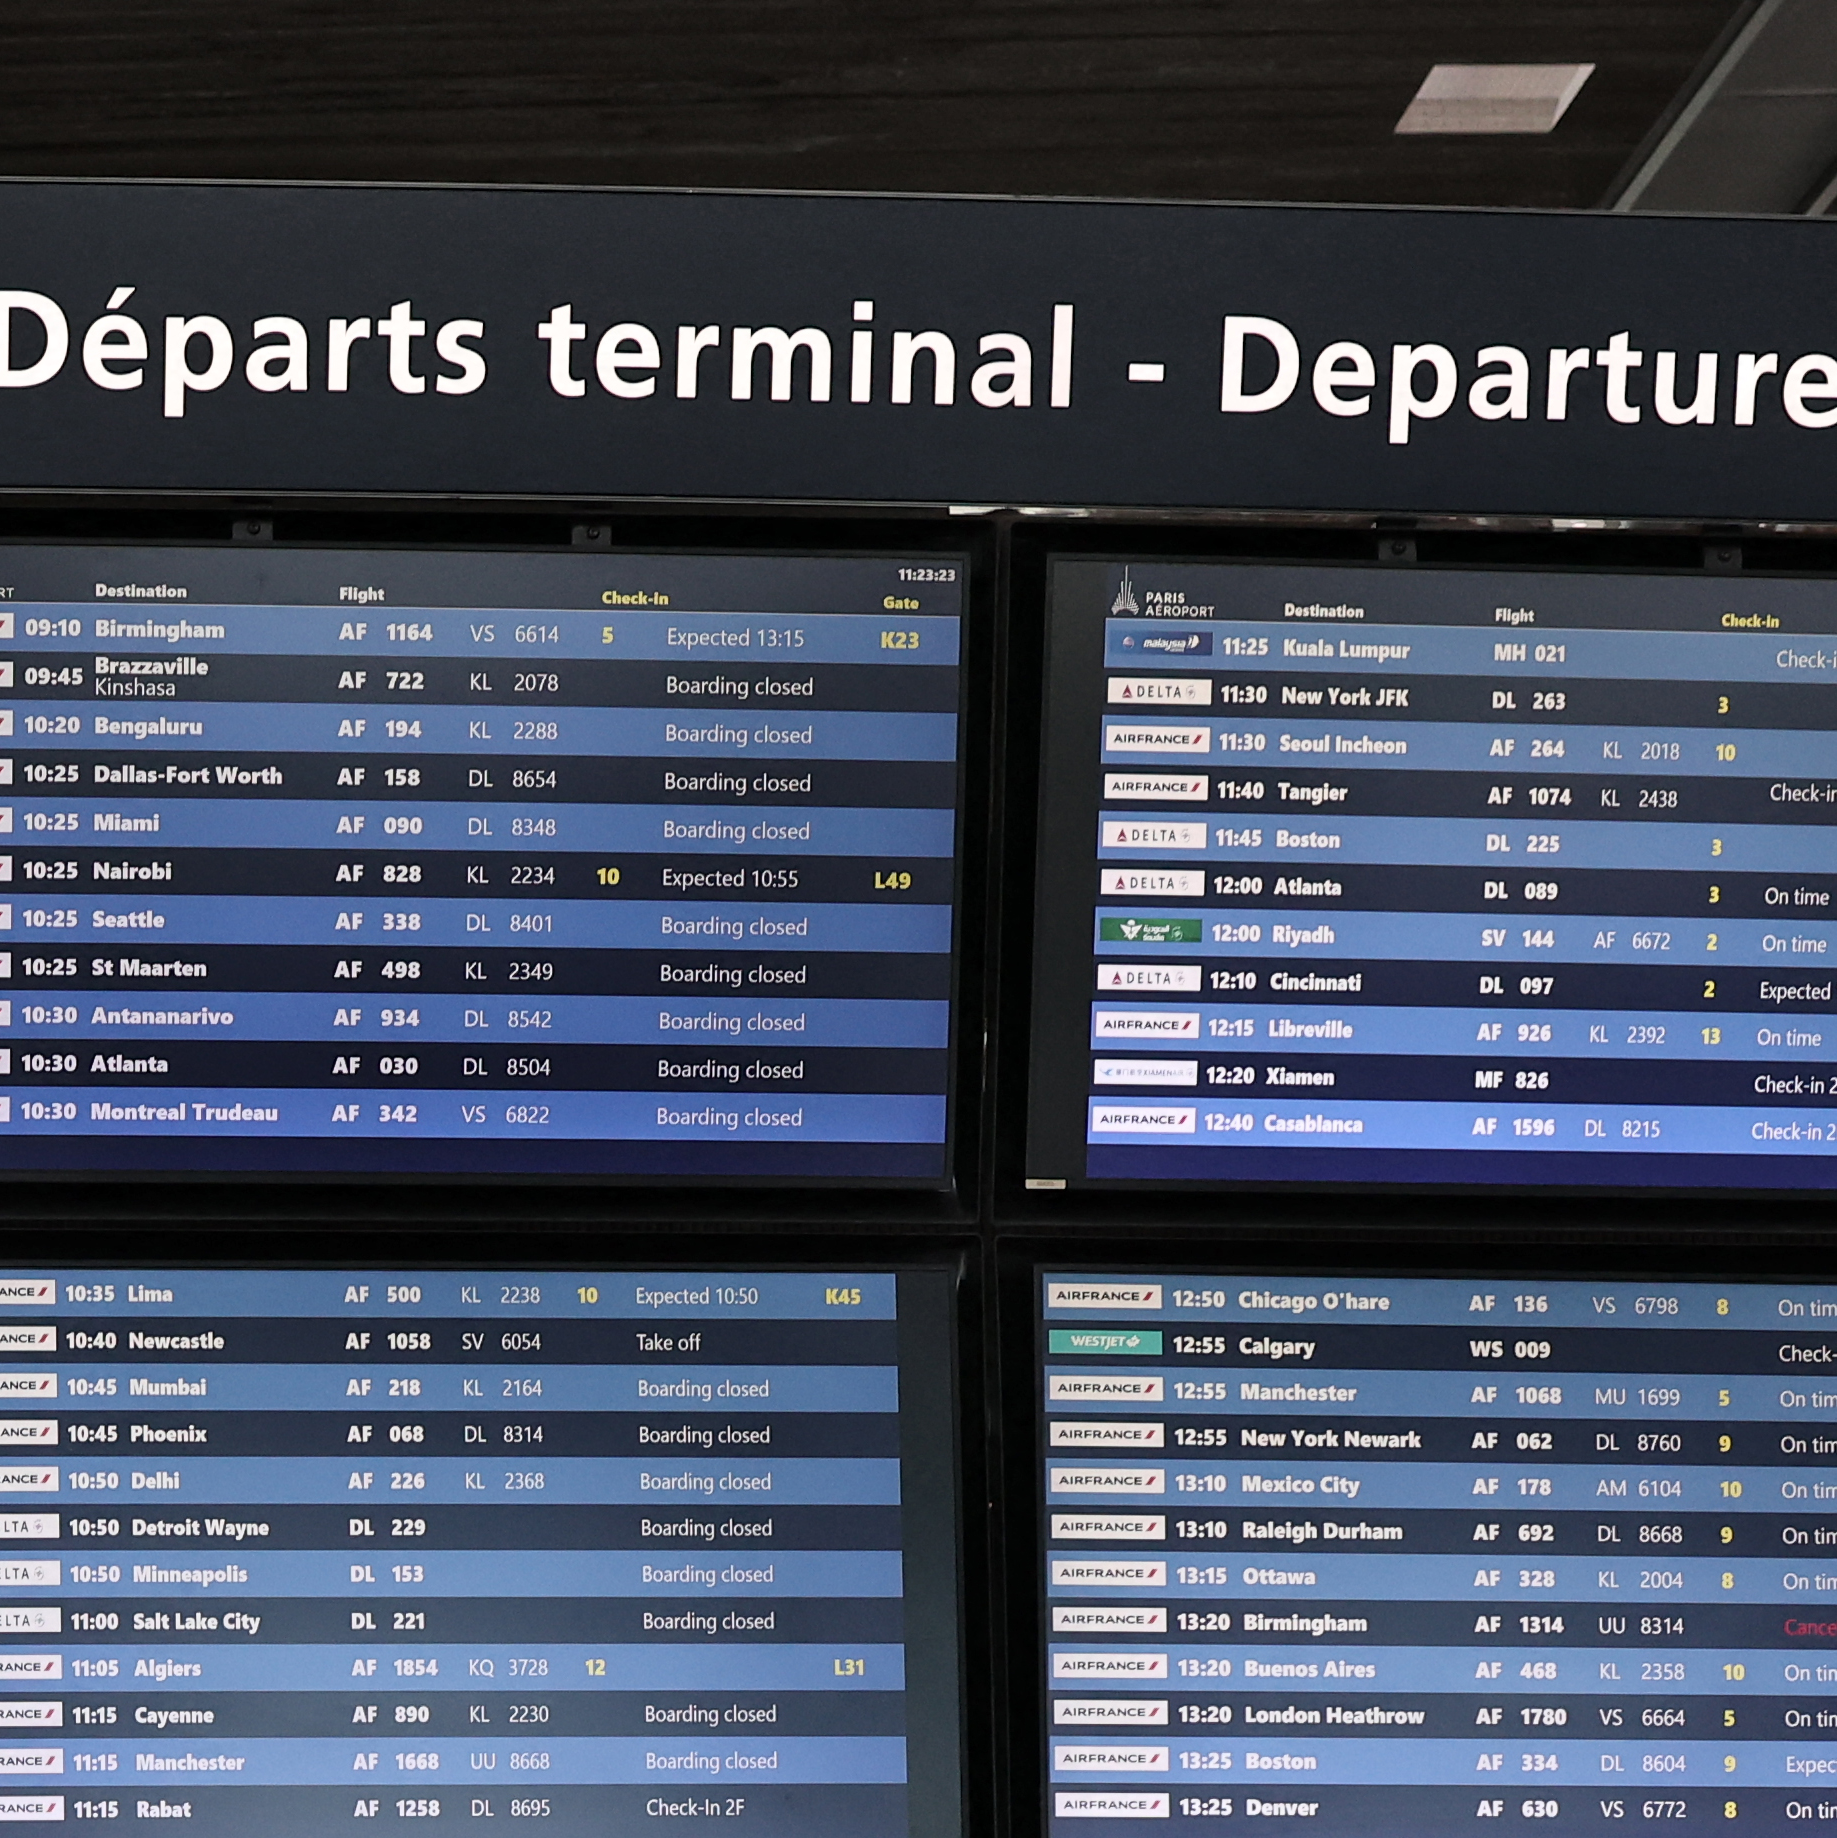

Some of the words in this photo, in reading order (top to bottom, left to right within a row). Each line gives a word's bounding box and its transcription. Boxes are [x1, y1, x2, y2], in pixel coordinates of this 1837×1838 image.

[538, 300, 1074, 408] terminal
[23, 861, 79, 880] 10:25
[93, 861, 172, 880] Nairobi
[335, 864, 364, 882] AF
[383, 864, 422, 883] 828
[467, 865, 489, 884] KL
[510, 866, 556, 885] 2234
[596, 867, 620, 885] 10
[662, 868, 745, 892] Expected
[751, 869, 799, 888] 10:55
[874, 871, 911, 890] L49
[1103, 1019, 1179, 1031] AIRFRANCE
[1208, 1018, 1255, 1037] 12:15
[1268, 1018, 1353, 1039] Libreville
[1476, 1022, 1503, 1041] AF
[1517, 1023, 1552, 1042] 926
[1589, 1024, 1609, 1043] KL
[1626, 1025, 1666, 1045] 2392
[1701, 1027, 1721, 1045] 13
[1757, 1028, 1782, 1046] On
[1786, 1028, 1822, 1047] time
[65, 1331, 117, 1349] 10:40
[128, 1331, 225, 1350] Newcastle
[345, 1332, 371, 1350] AF
[387, 1332, 431, 1350] 1058
[461, 1332, 485, 1351] SV
[501, 1332, 542, 1351] 6054
[635, 1332, 674, 1351] Take
[677, 1332, 701, 1352] off
[1060, 1614, 1145, 1625] AIRFRANCE
[1177, 1612, 1231, 1631] 13:20
[1243, 1613, 1368, 1637] Birmingham
[1474, 1615, 1502, 1633] AF
[1519, 1616, 1565, 1634] 1314
[1598, 1616, 1626, 1635] UU
[1640, 1616, 1684, 1635] 8314
